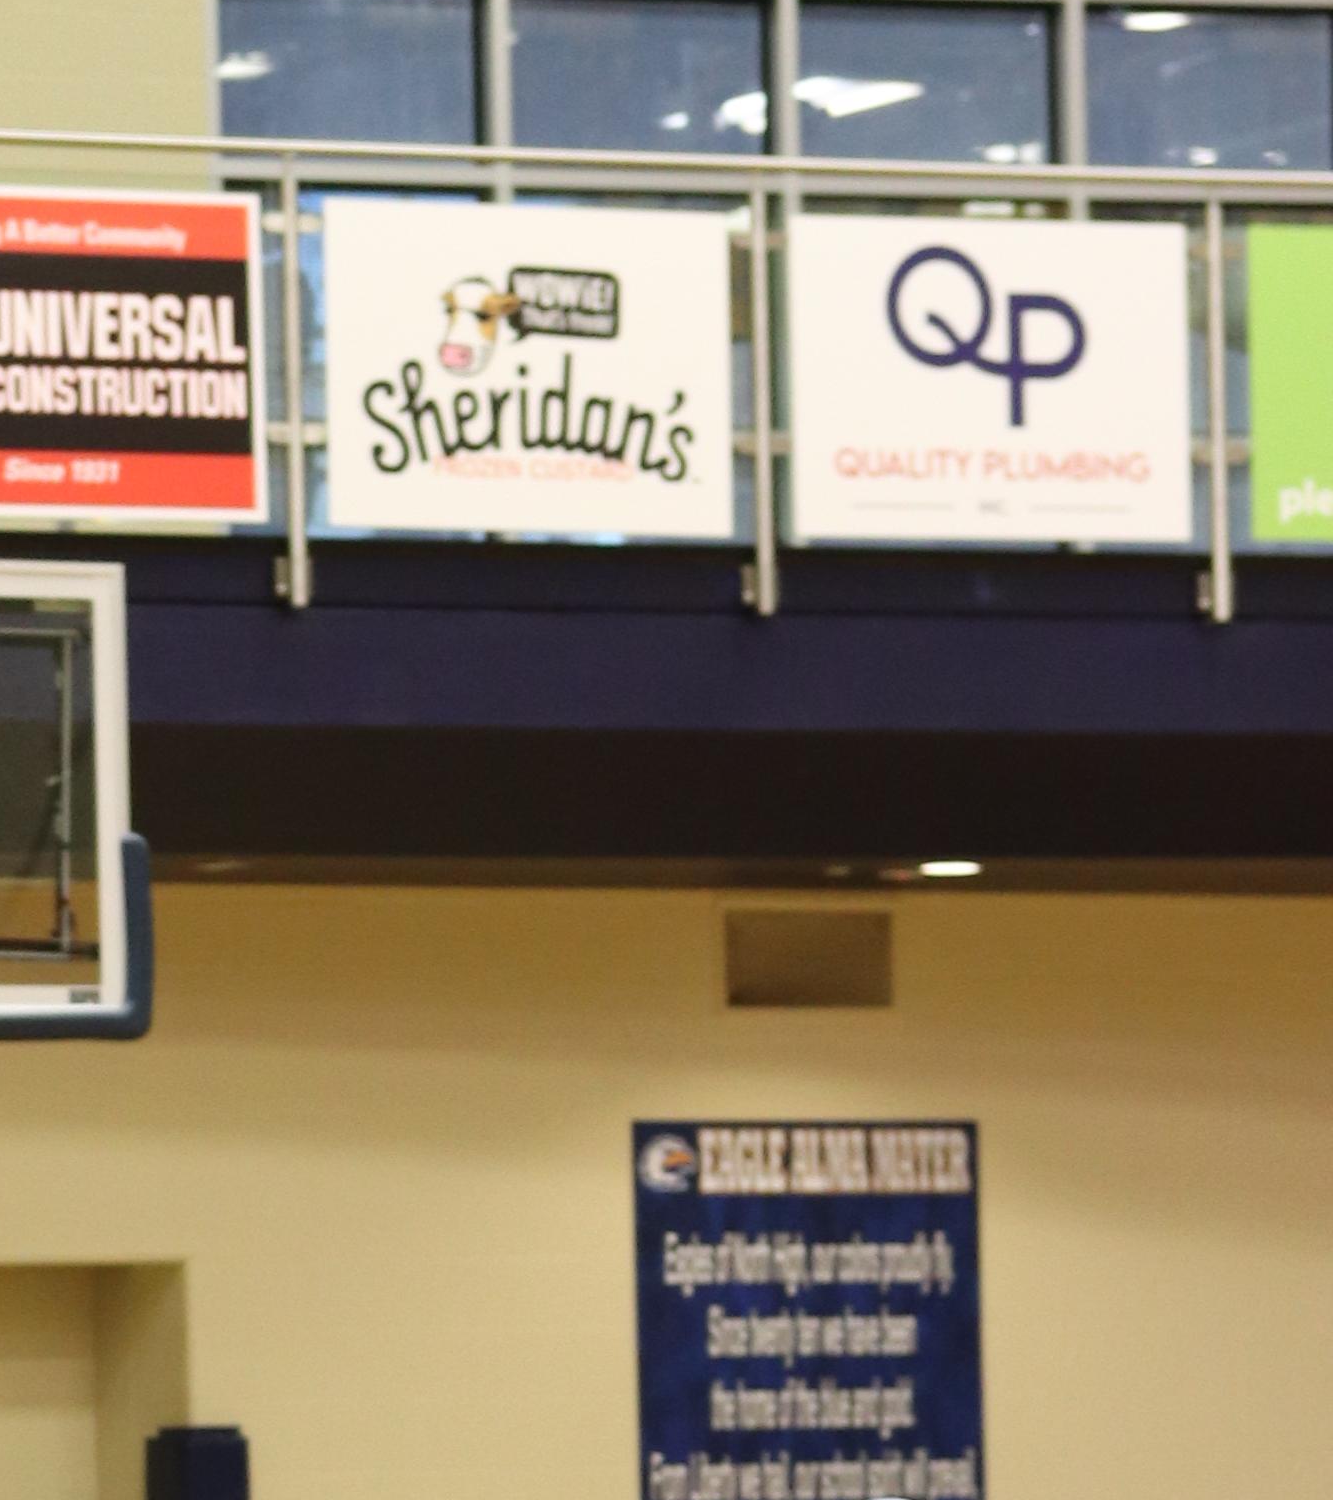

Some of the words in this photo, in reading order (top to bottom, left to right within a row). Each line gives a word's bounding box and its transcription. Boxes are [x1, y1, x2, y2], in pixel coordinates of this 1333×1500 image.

[886, 245, 1087, 427] QP
[362, 351, 695, 484] Sheridan's
[834, 446, 973, 480] QUALITY
[982, 449, 1151, 484] PLUMBING
